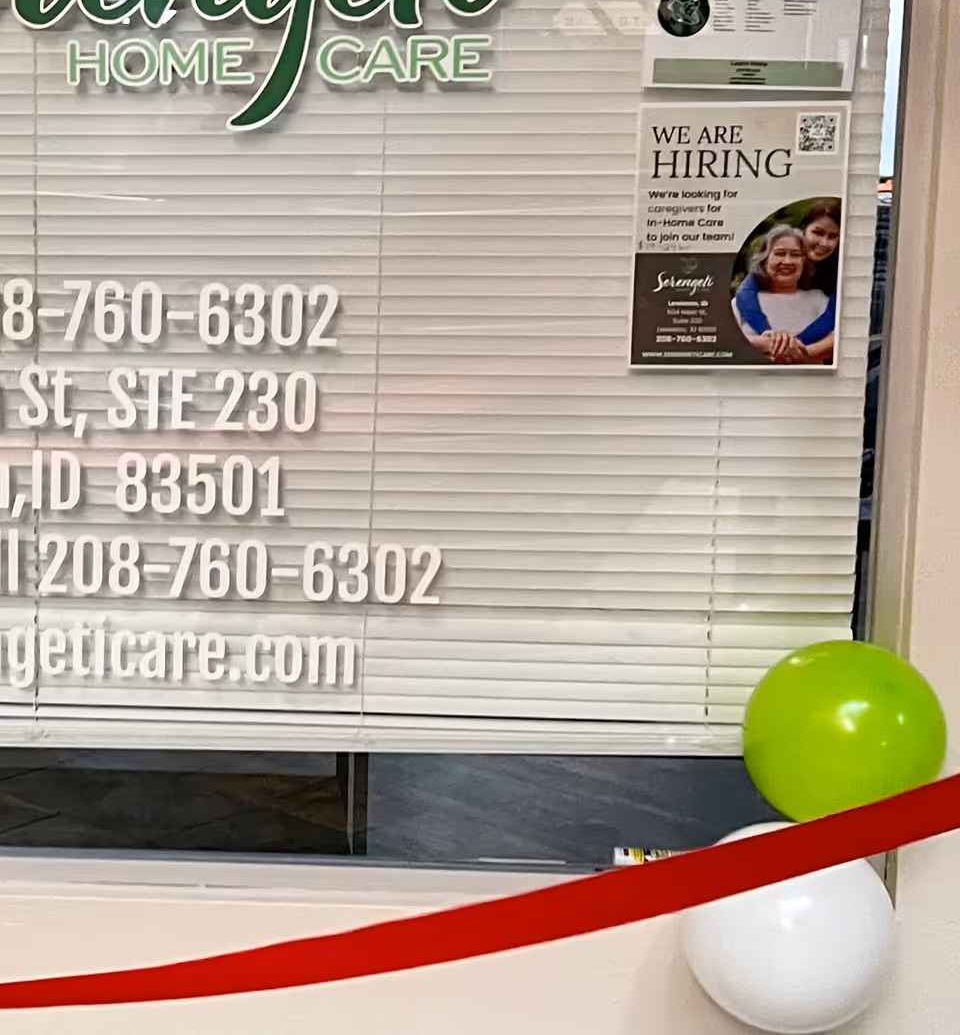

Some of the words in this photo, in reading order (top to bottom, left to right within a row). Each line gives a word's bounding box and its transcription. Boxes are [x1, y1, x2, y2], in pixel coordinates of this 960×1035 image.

[67, 37, 255, 87] HOME
[316, 34, 492, 85] CARE
[651, 126, 691, 144] WE
[697, 125, 743, 144] ARE
[651, 148, 793, 179] HIRING
[648, 190, 680, 199] We're
[681, 190, 721, 201] looking
[723, 189, 739, 198] for
[646, 218, 695, 227] In-Home
[697, 218, 725, 227] Care
[648, 205, 705, 216] caregivers
[707, 204, 722, 213] for
[646, 232, 658, 241] to
[659, 232, 680, 243] join
[681, 233, 700, 241] our
[702, 232, 735, 241] team!
[652, 270, 715, 296] Serengeti
[18, 364, 88, 438] St,
[107, 367, 197, 430] STE
[214, 369, 317, 433] 230
[115, 452, 286, 517] 83501
[38, 533, 442, 605] 208-760-6302
